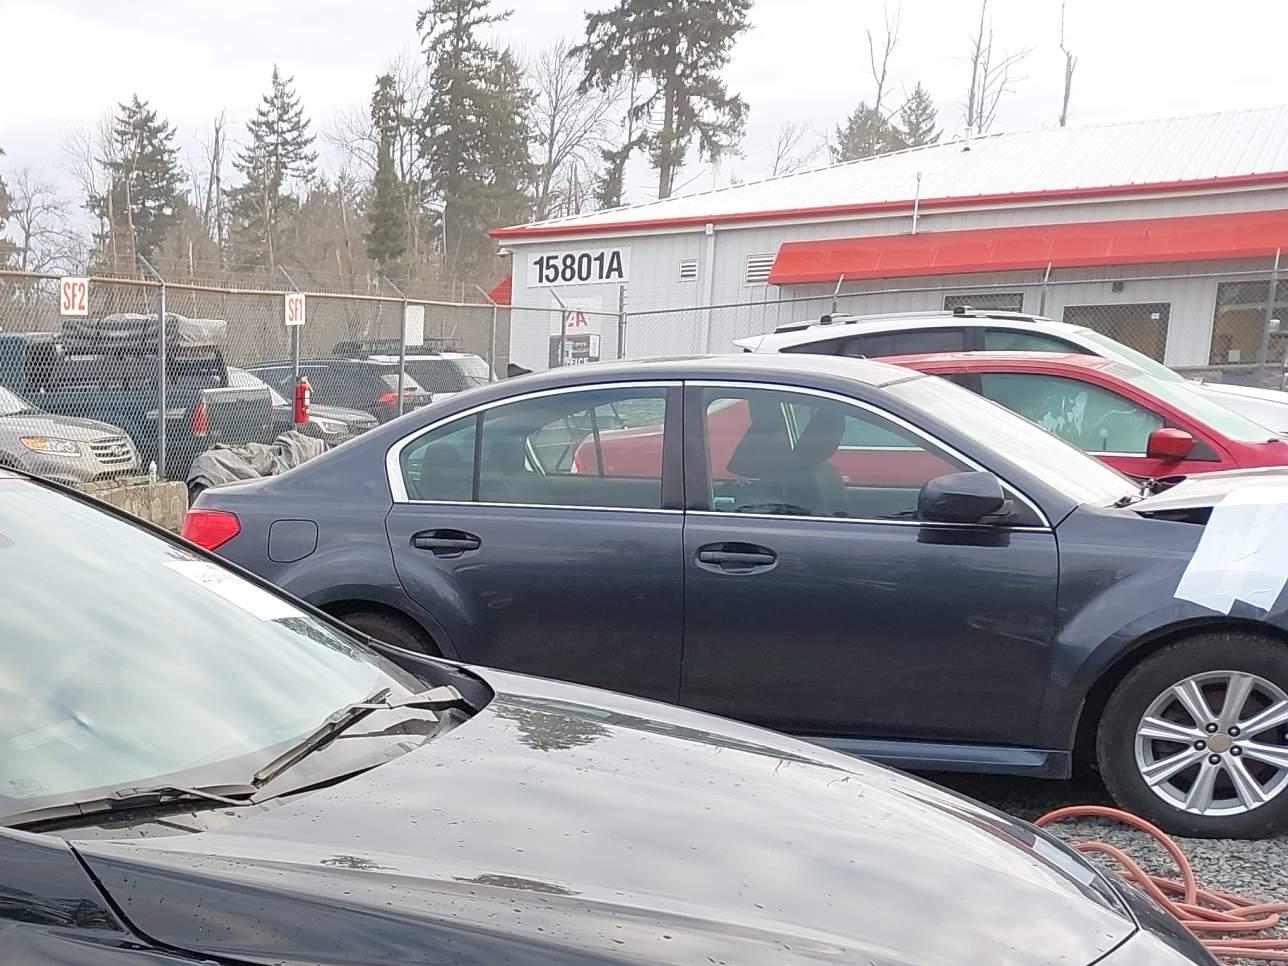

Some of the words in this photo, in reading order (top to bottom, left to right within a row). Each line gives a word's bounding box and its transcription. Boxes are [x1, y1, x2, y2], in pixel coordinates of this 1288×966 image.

[533, 250, 623, 284] 15801A
[63, 281, 86, 311] SF2
[288, 297, 303, 321] SF1
